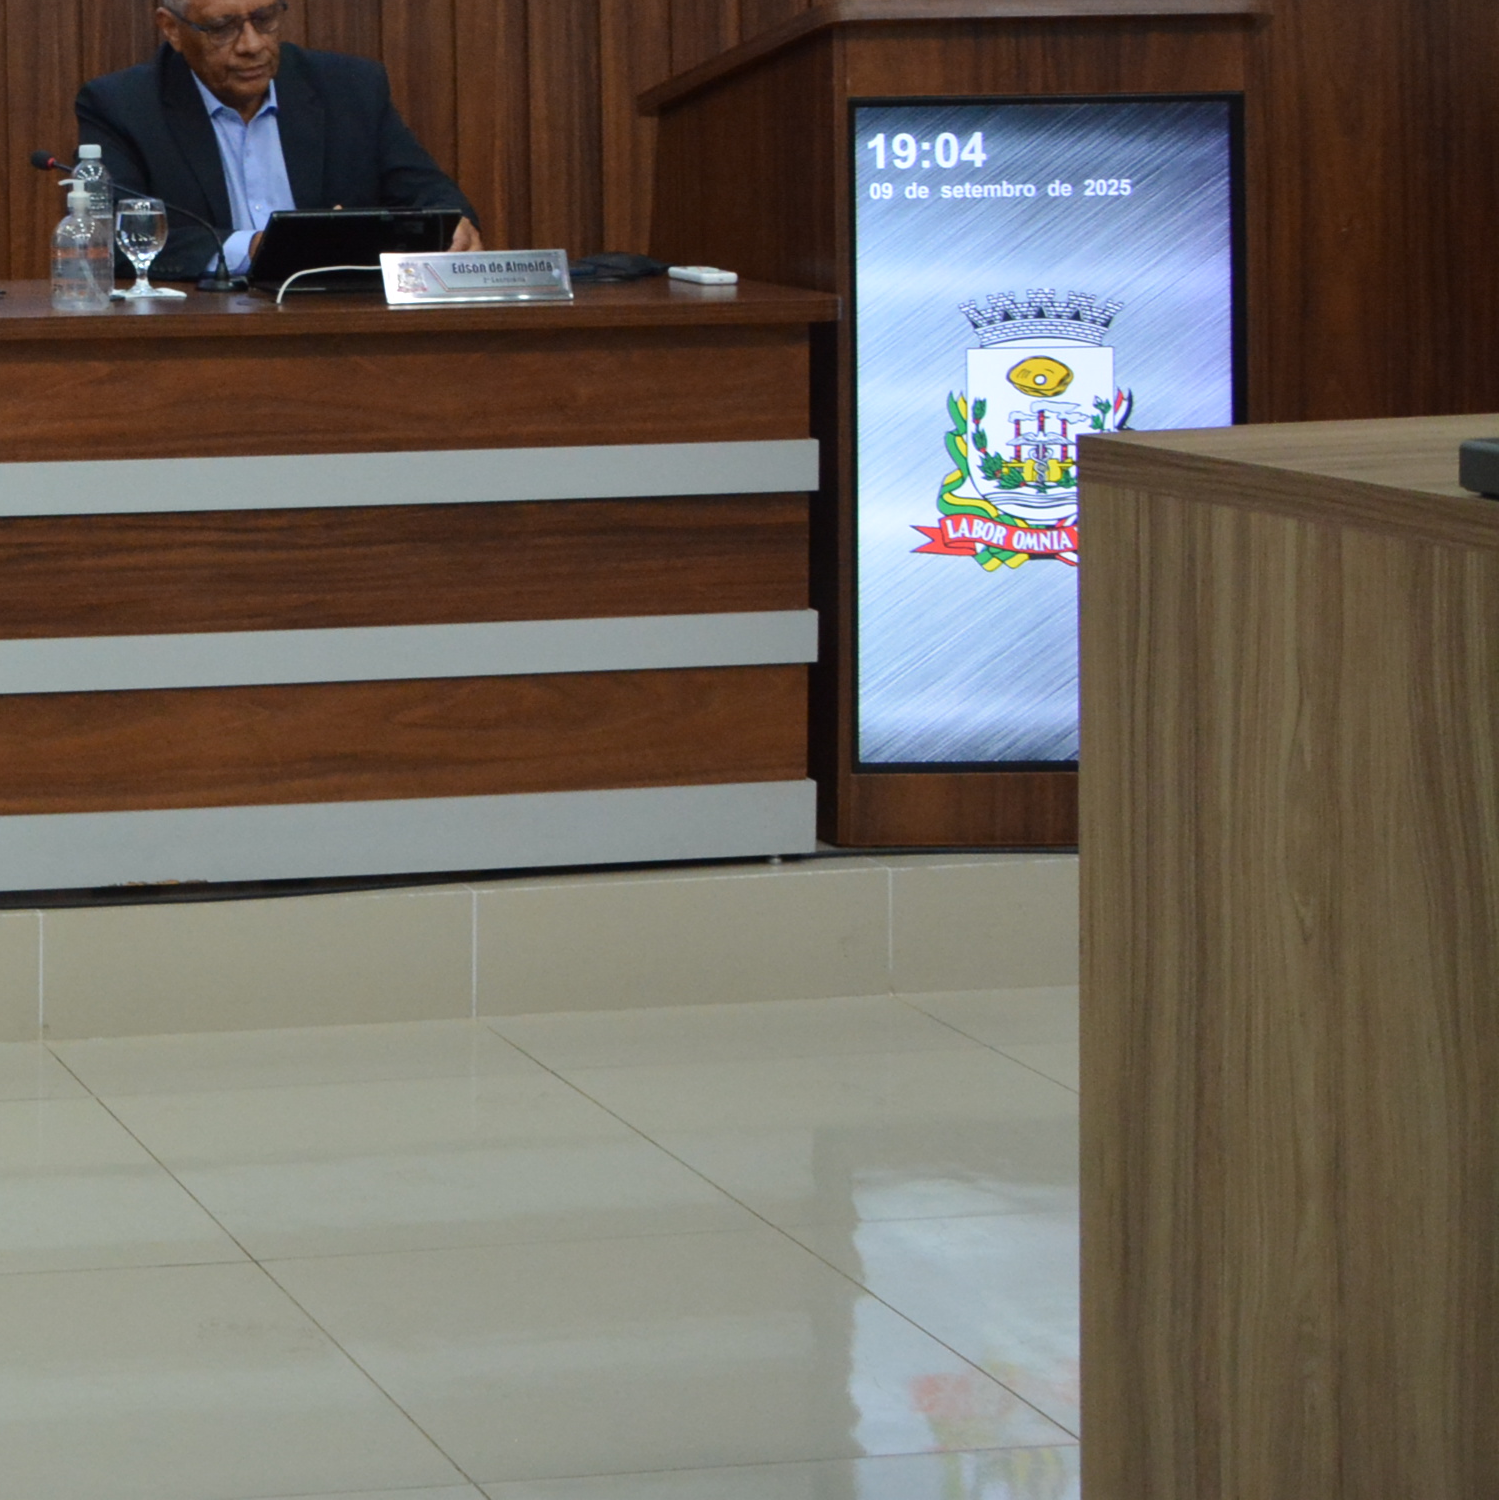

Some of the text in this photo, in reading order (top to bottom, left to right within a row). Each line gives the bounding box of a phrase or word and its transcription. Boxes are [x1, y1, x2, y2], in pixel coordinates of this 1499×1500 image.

[867, 131, 987, 169] 19:04
[869, 179, 1131, 200] 09 de setembro de 2025
[451, 260, 553, 274] Edson de Almeida
[945, 518, 1073, 551] LABOR OMNIA
